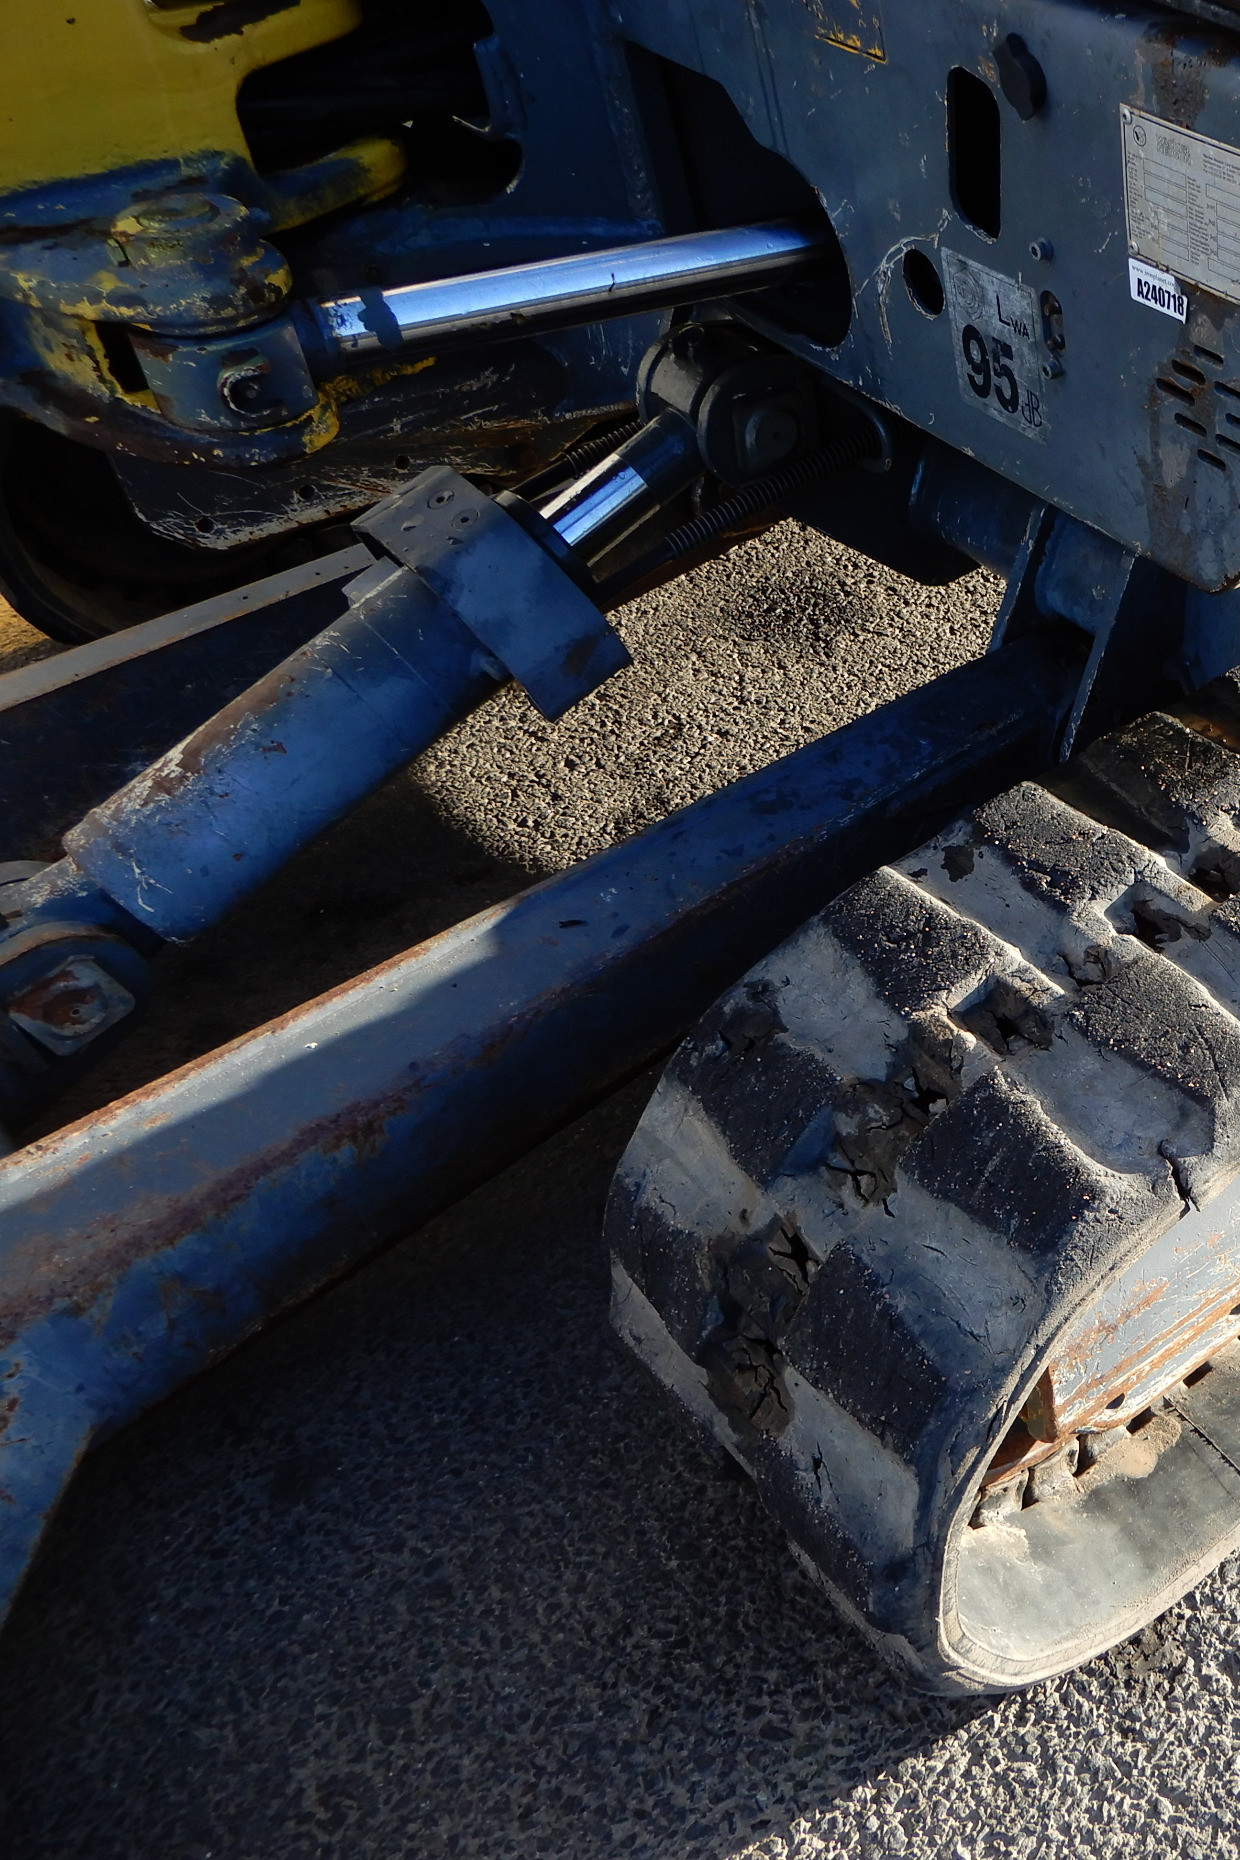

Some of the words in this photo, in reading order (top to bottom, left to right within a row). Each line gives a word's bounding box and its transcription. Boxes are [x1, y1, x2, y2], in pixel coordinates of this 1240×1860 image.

[1137, 277, 1184, 317] A240718
[962, 324, 1020, 414] 95
[1021, 389, 1043, 428] dB
